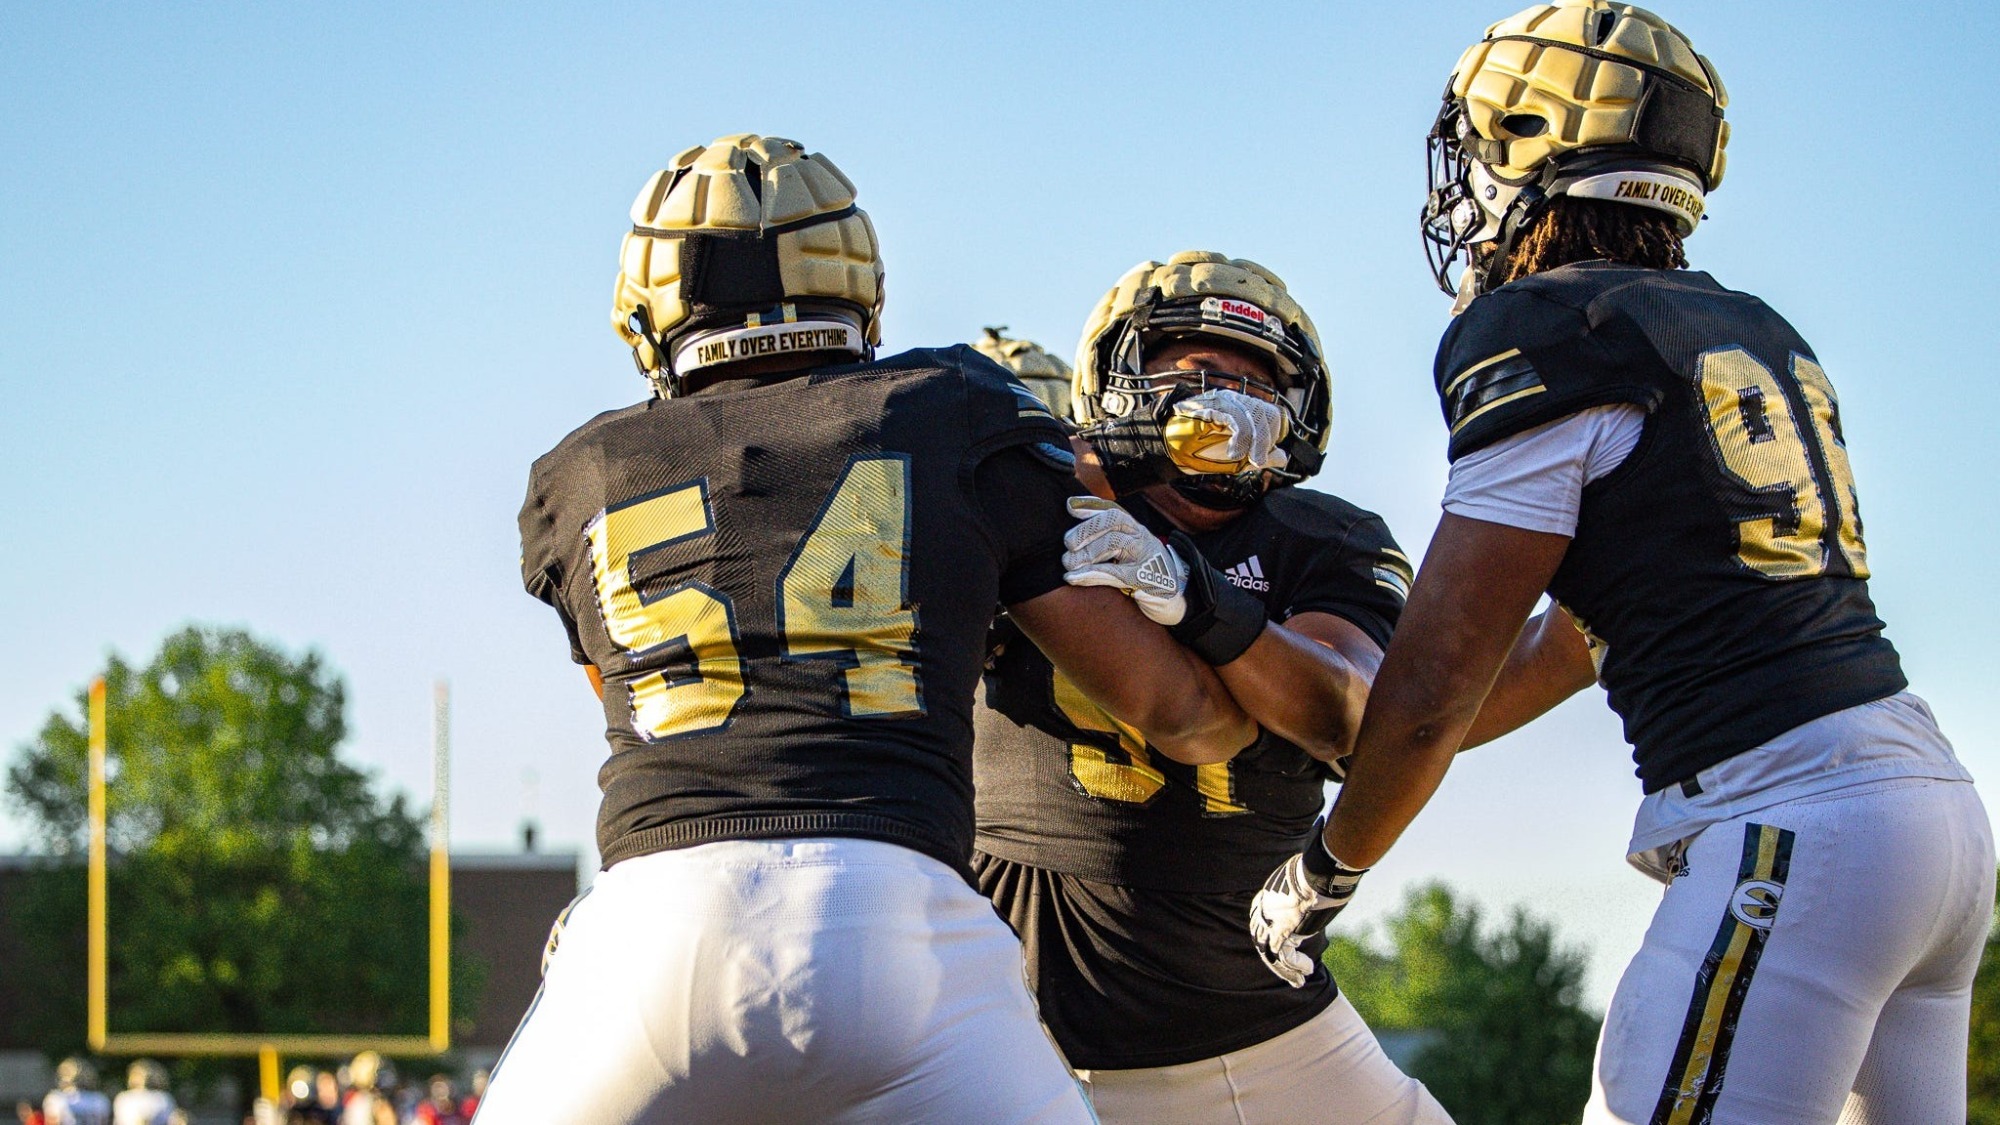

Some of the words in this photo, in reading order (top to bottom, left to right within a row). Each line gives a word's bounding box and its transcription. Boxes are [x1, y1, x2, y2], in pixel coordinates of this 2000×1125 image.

[1614, 181, 1660, 200] FAMILY
[1661, 186, 1687, 209] OVER
[1222, 301, 1264, 321] Riddell
[697, 339, 735, 364] FAMILY
[740, 335, 776, 356] OVER
[779, 328, 848, 351] EVERYTHING
[1139, 569, 1175, 589] adidas
[1225, 575, 1270, 592] didas
[583, 451, 927, 744] 54
